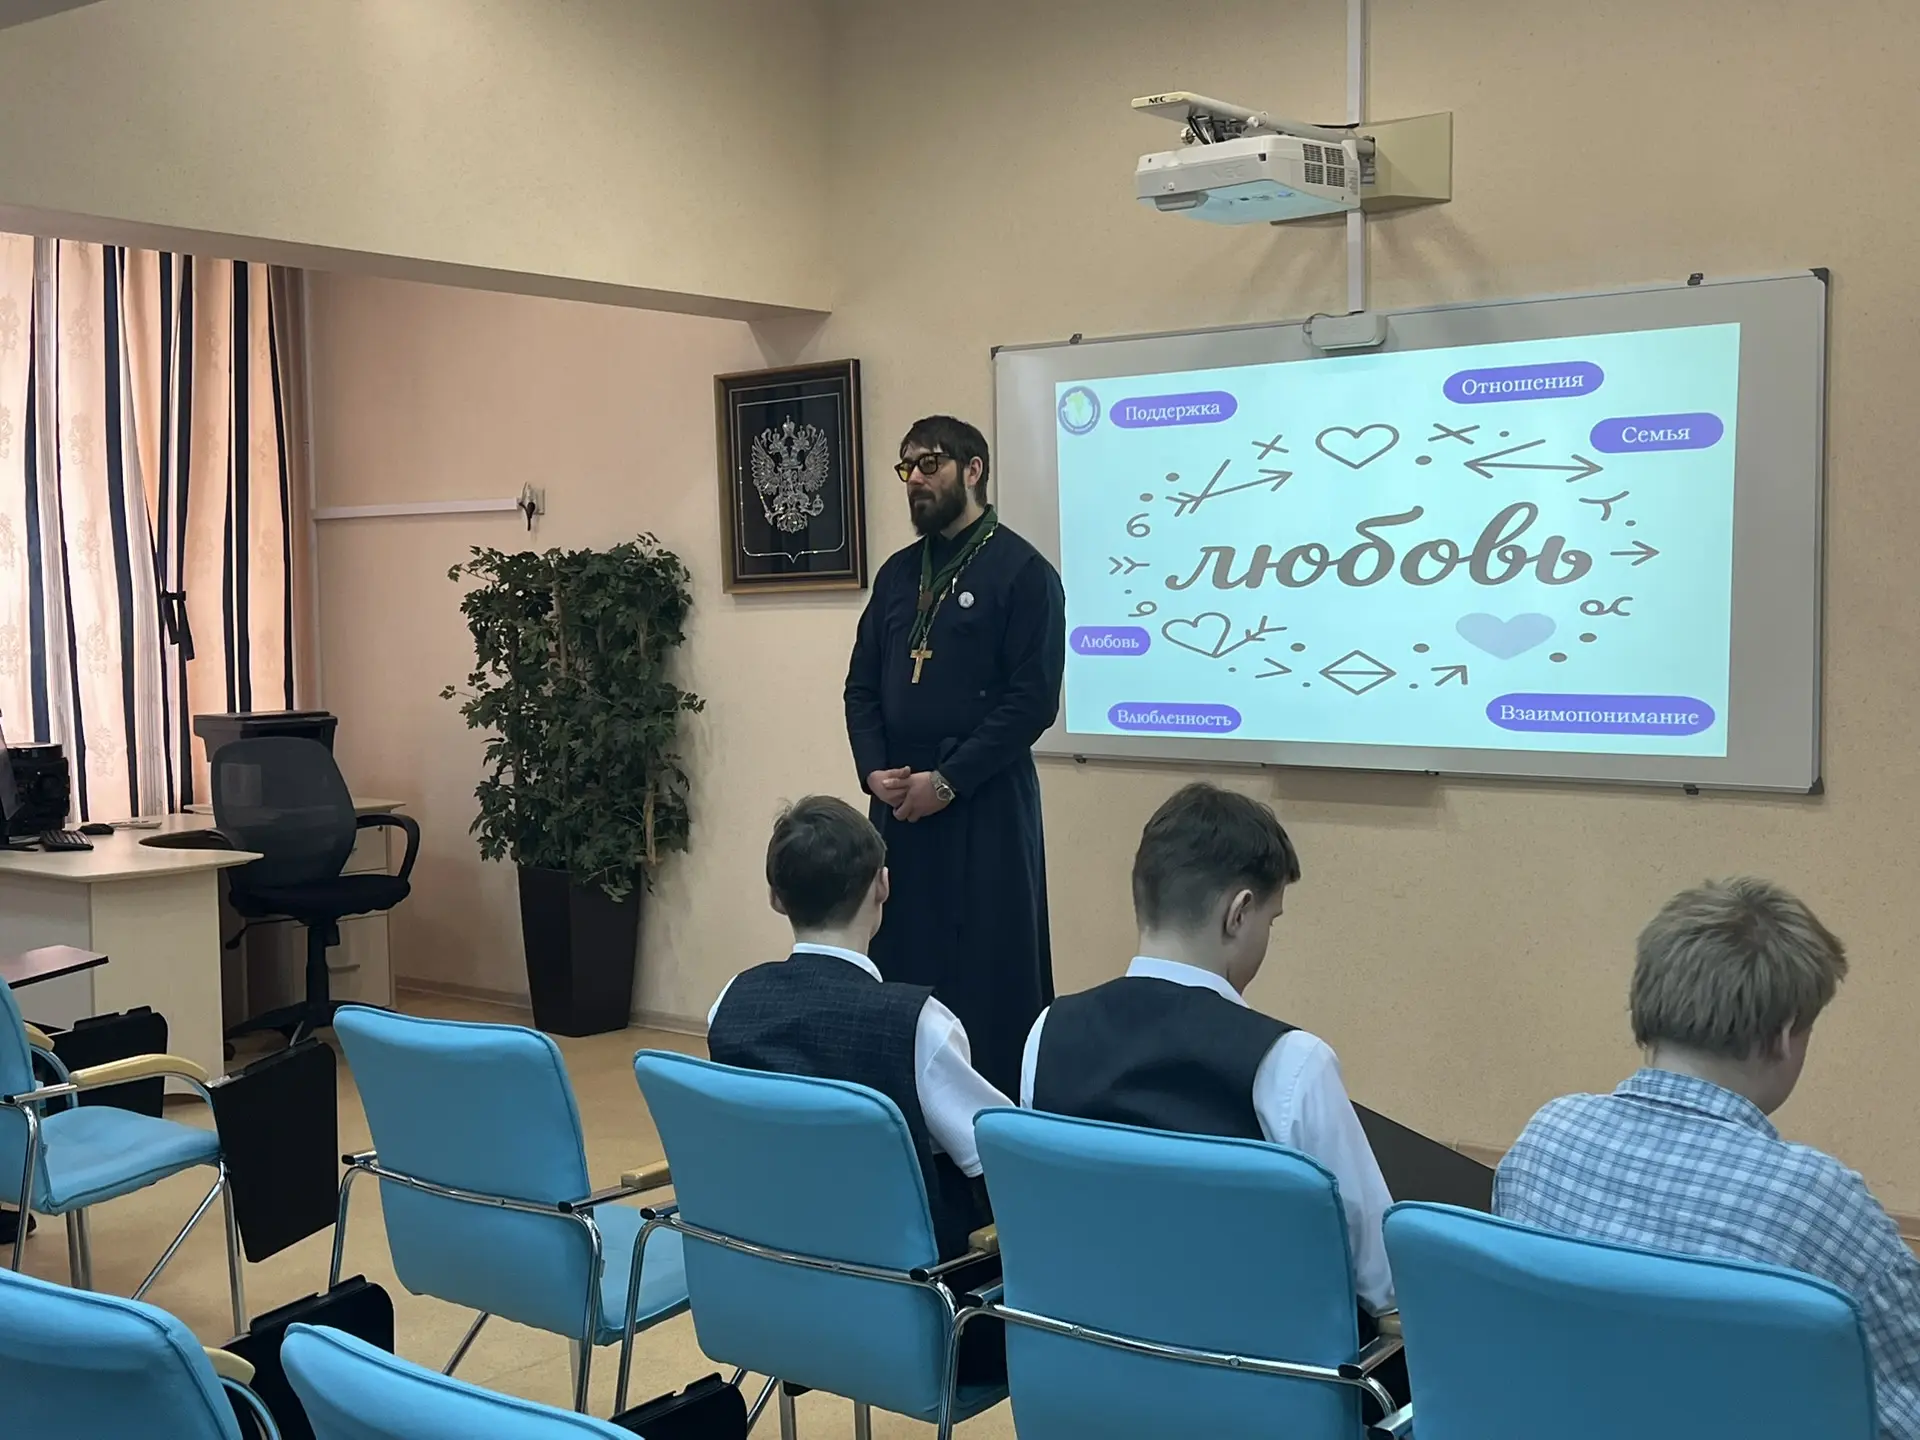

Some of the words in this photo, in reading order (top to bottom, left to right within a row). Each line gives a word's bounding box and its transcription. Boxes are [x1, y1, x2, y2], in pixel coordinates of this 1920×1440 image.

[1461, 373, 1584, 396] Отношения
[1125, 401, 1221, 422] Поддержка
[1621, 426, 1690, 444] Семья
[1164, 501, 1593, 591] любовь
[1080, 634, 1139, 649] Любовь
[1117, 709, 1232, 727] Влюбленность
[1500, 704, 1699, 726] Взаимопонимание
